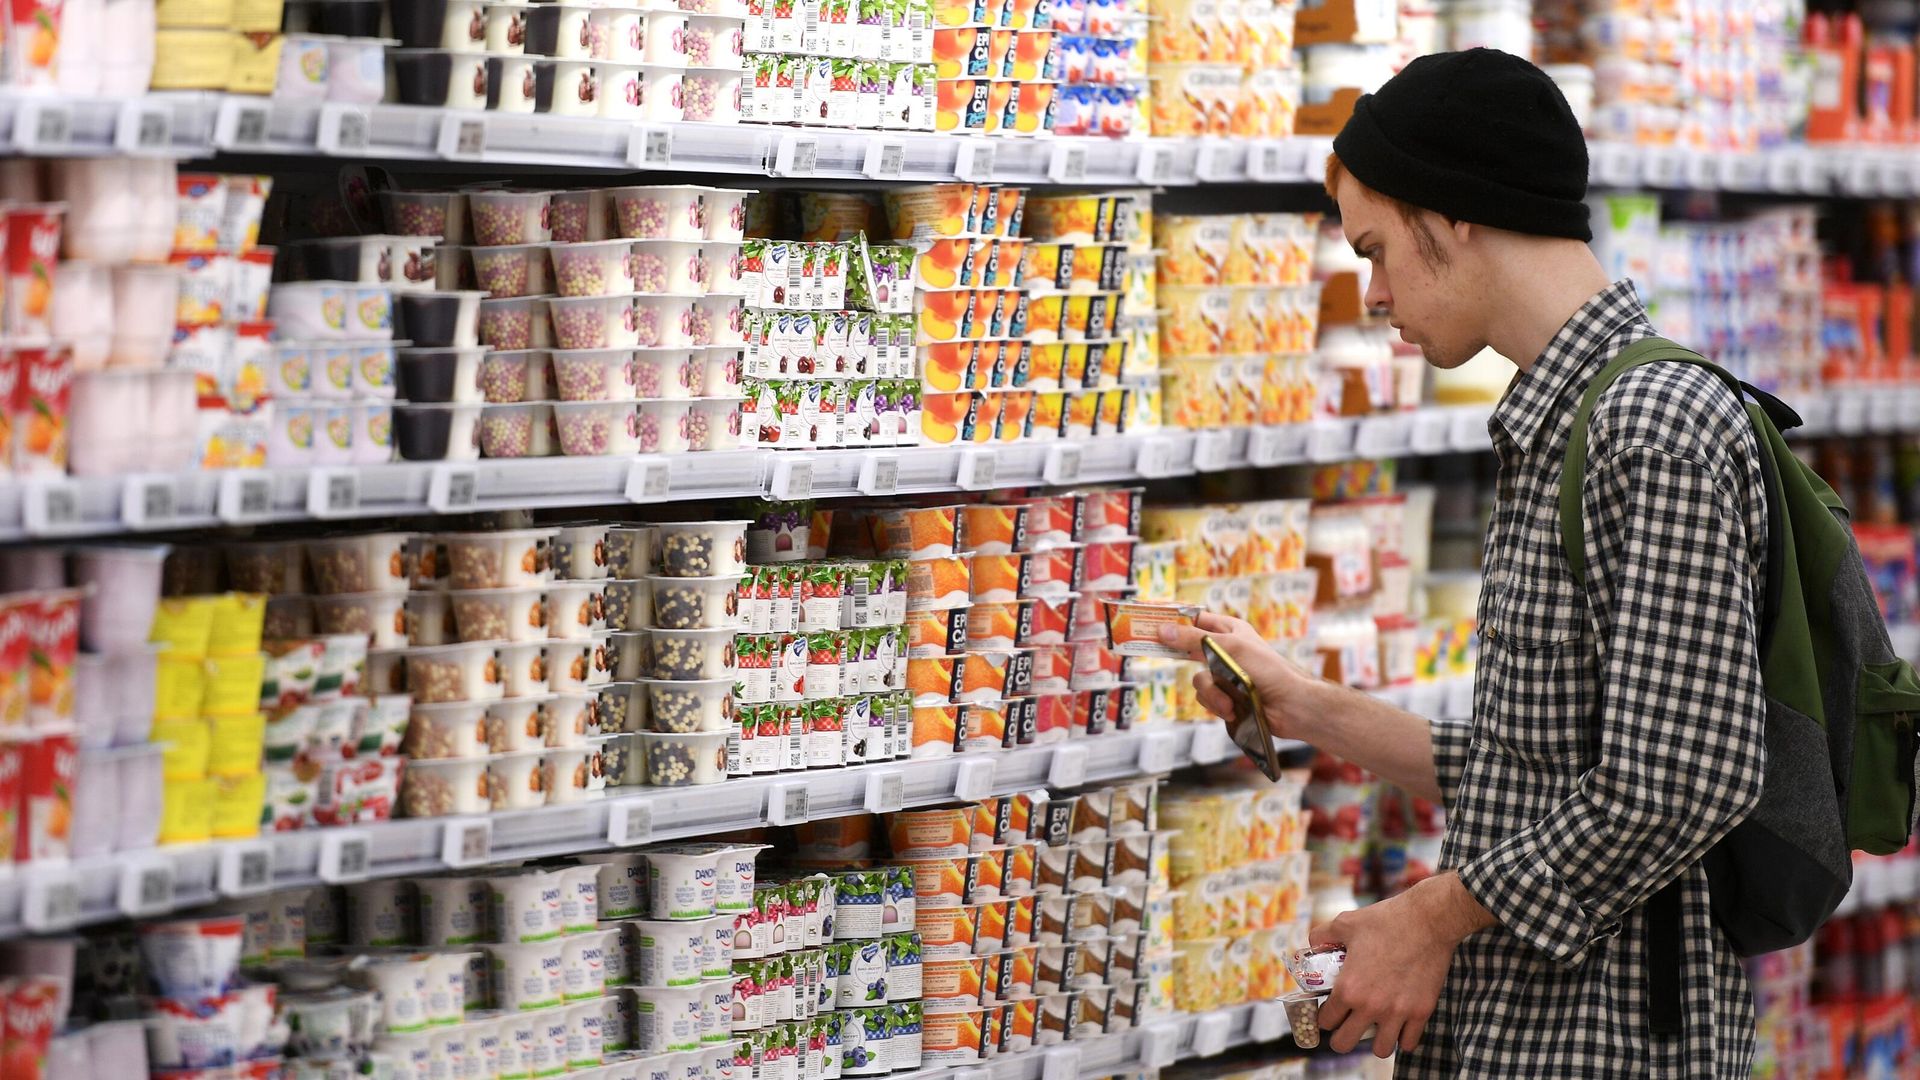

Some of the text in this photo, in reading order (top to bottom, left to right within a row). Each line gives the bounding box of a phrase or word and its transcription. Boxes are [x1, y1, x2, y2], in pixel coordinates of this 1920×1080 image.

[1015, 672, 1030, 685] CA
[1053, 807, 1070, 821] EPI
[1050, 821, 1067, 835] CA
